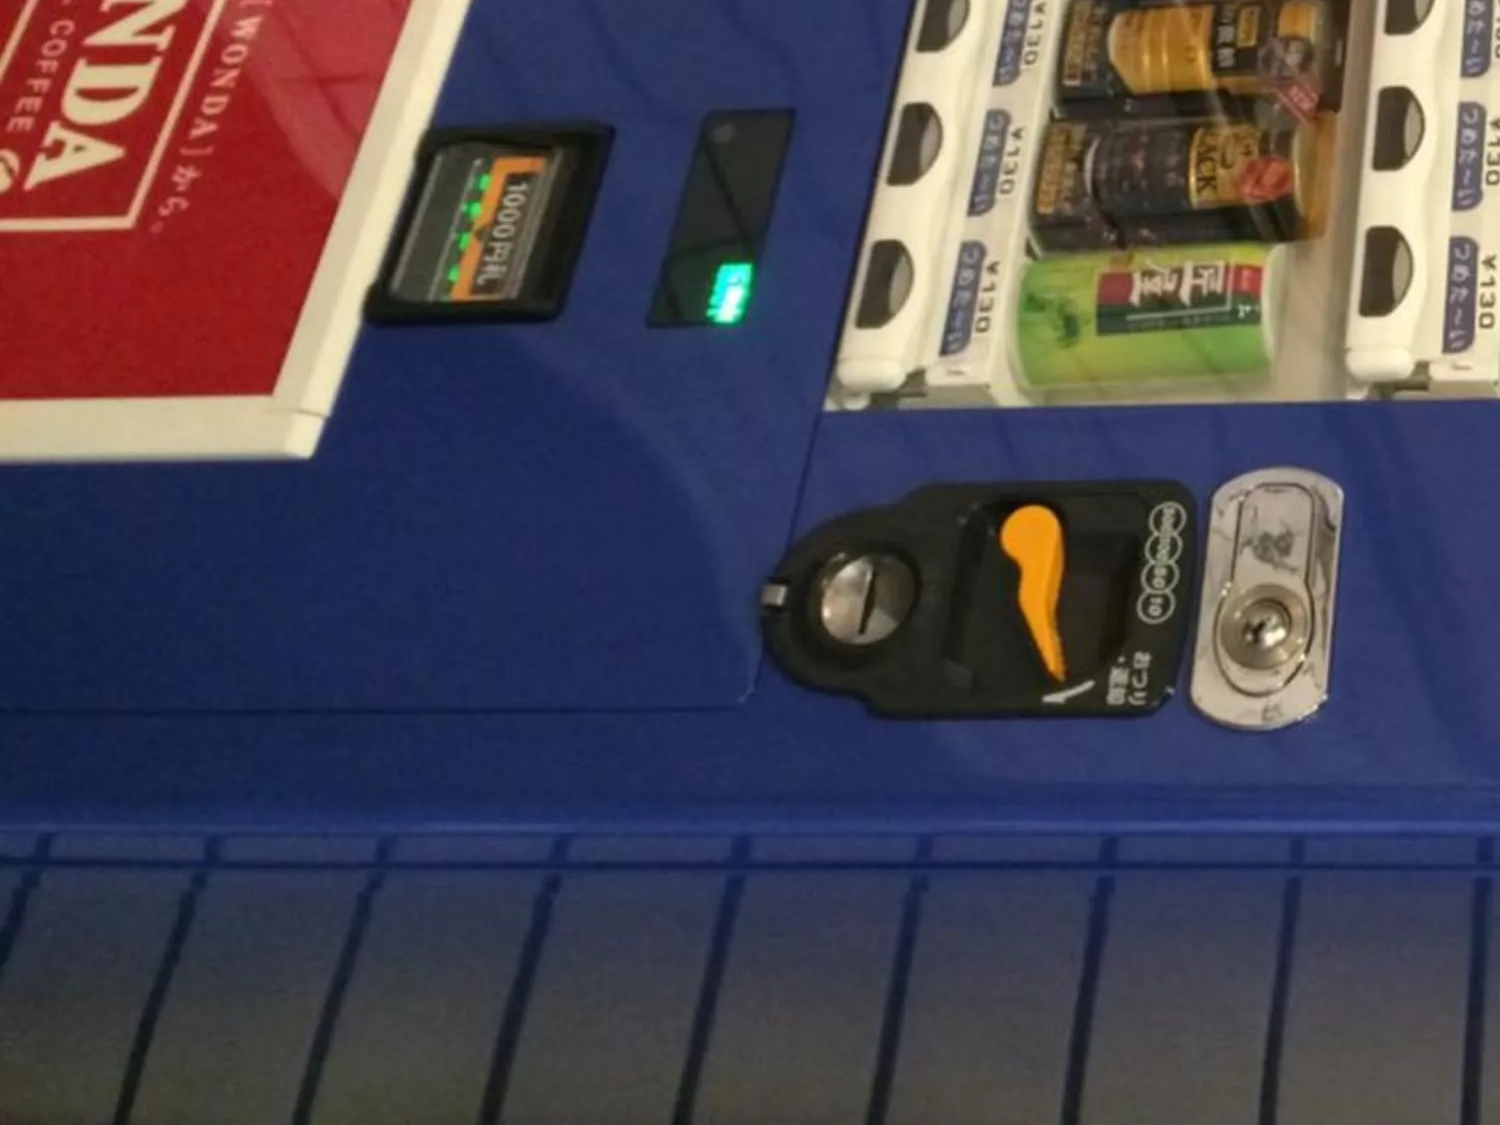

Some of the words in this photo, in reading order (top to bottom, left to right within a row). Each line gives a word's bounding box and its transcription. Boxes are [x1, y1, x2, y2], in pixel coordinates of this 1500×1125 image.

[1023, 1, 1046, 66] ¥130
[6, 19, 76, 134] COFFEE
[999, 127, 1024, 196] ¥130
[475, 181, 531, 286] 1000円札
[975, 260, 1000, 334] ¥130
[1478, 254, 1497, 330] ¥130
[1149, 597, 1163, 617] 10
[1127, 650, 1153, 706] おつり
